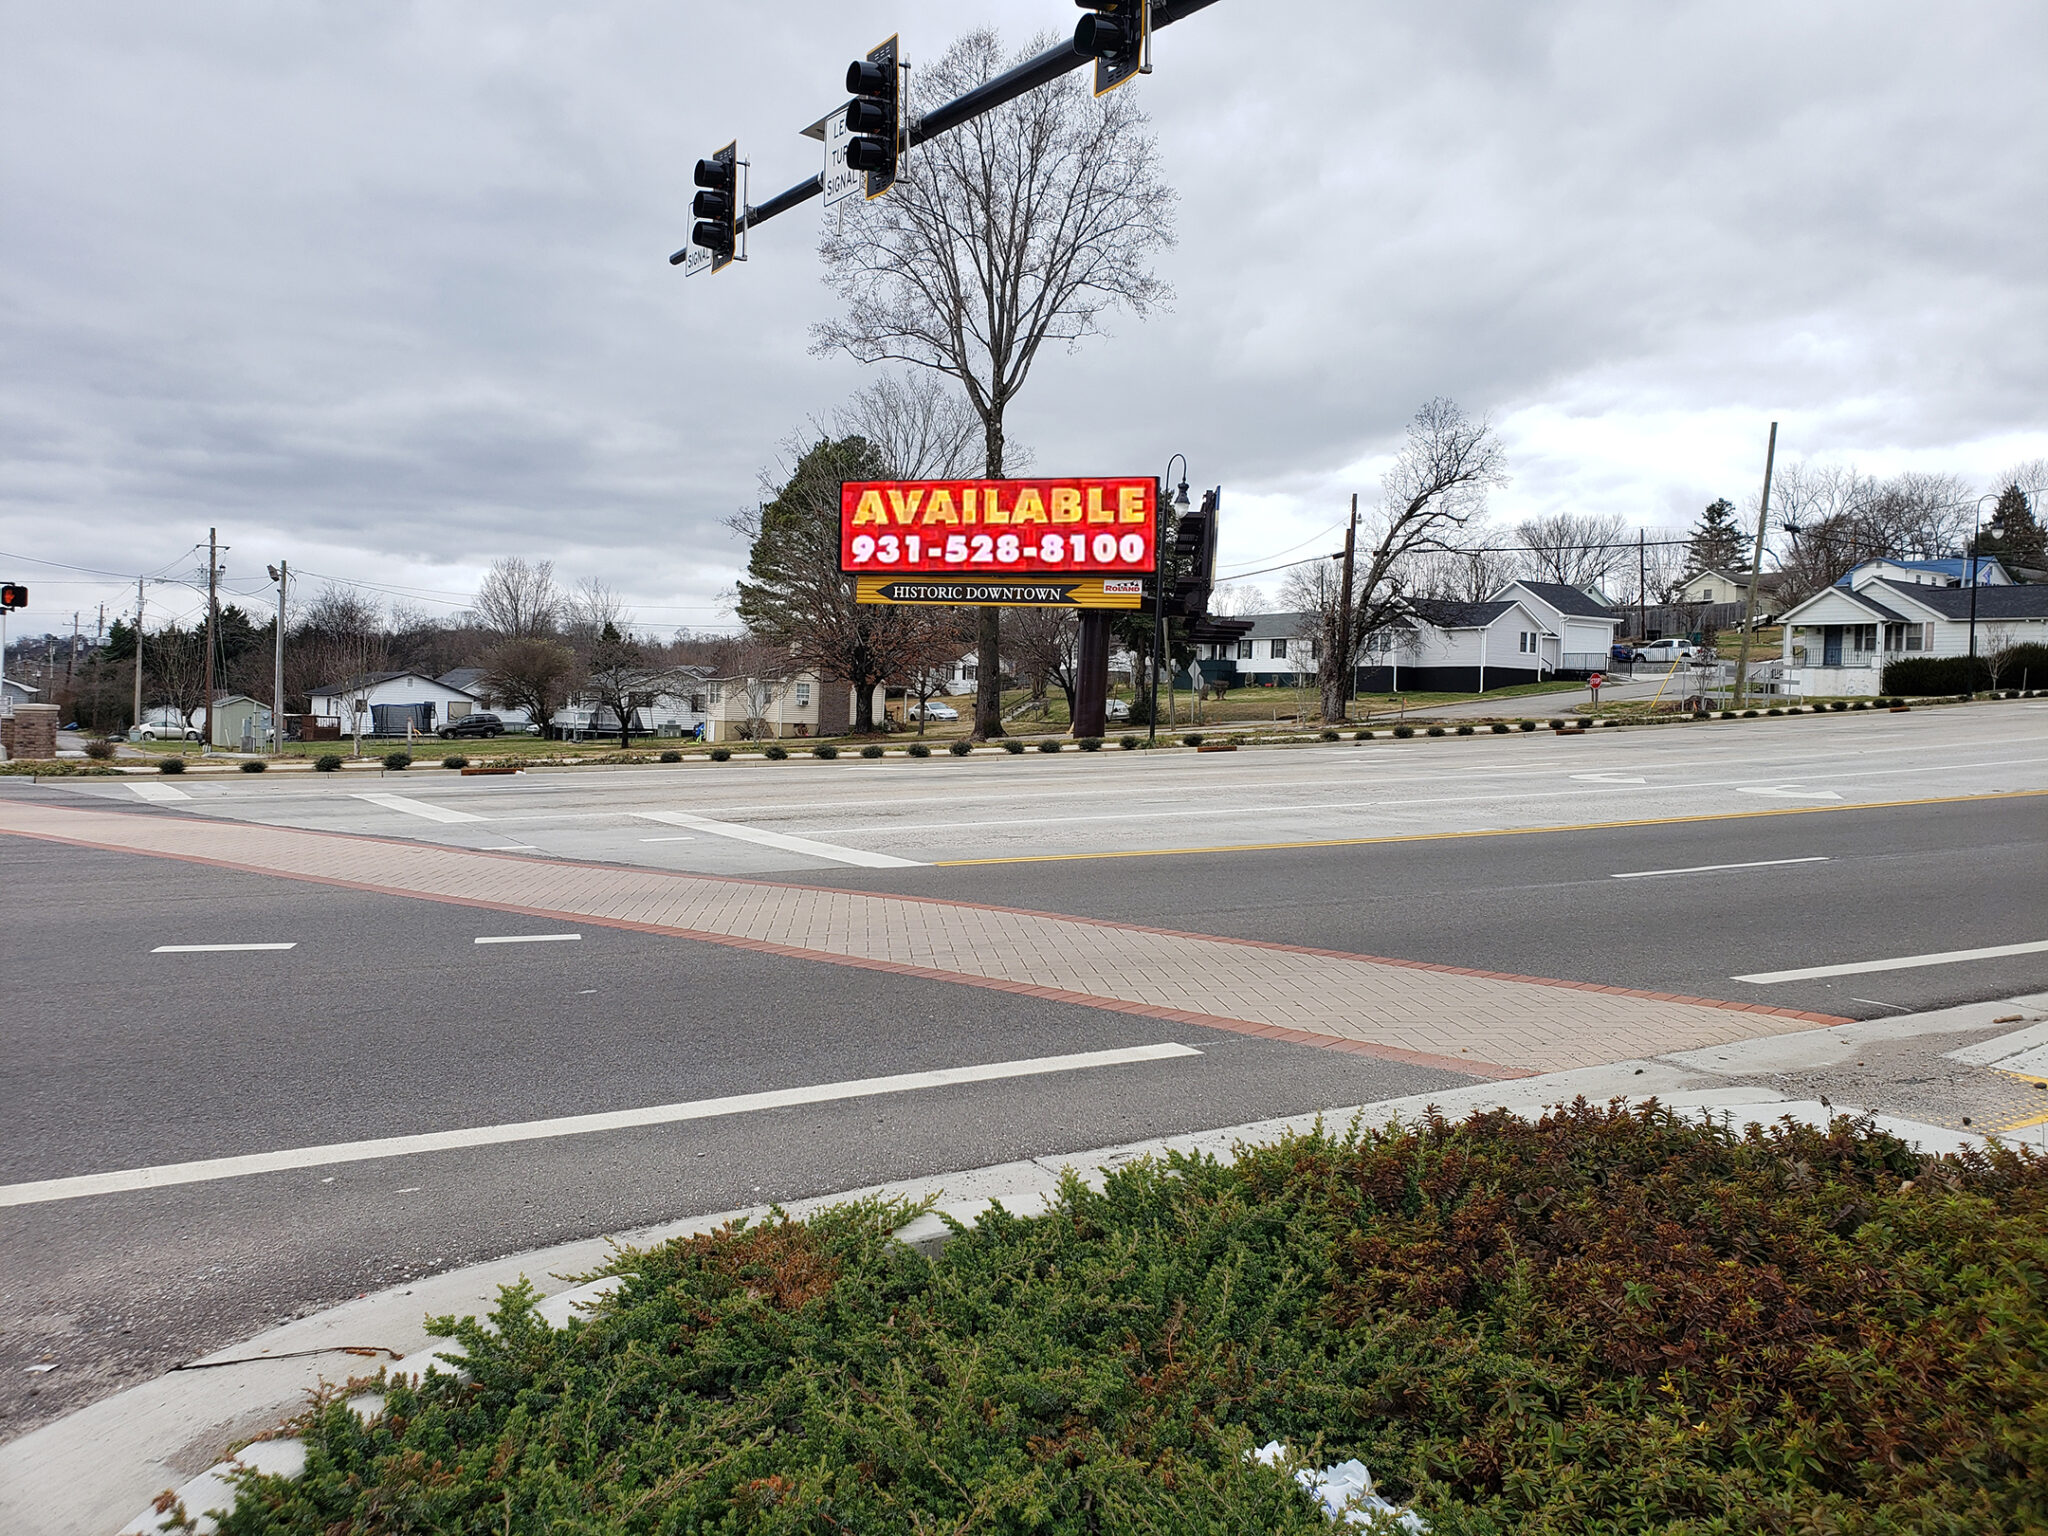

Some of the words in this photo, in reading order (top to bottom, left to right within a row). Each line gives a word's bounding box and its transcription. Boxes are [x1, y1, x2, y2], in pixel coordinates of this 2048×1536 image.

[833, 118, 848, 139] LE
[832, 144, 849, 167] TUR
[827, 169, 858, 196] SIGNAL
[687, 248, 710, 269] SIGNAL
[852, 487, 1146, 525] AVAILABLE
[851, 534, 1145, 564] 931-528-8100
[893, 586, 963, 599] HISTORIC
[966, 587, 1062, 600] DOWNTOWN
[1591, 677, 1601, 685] STOP
